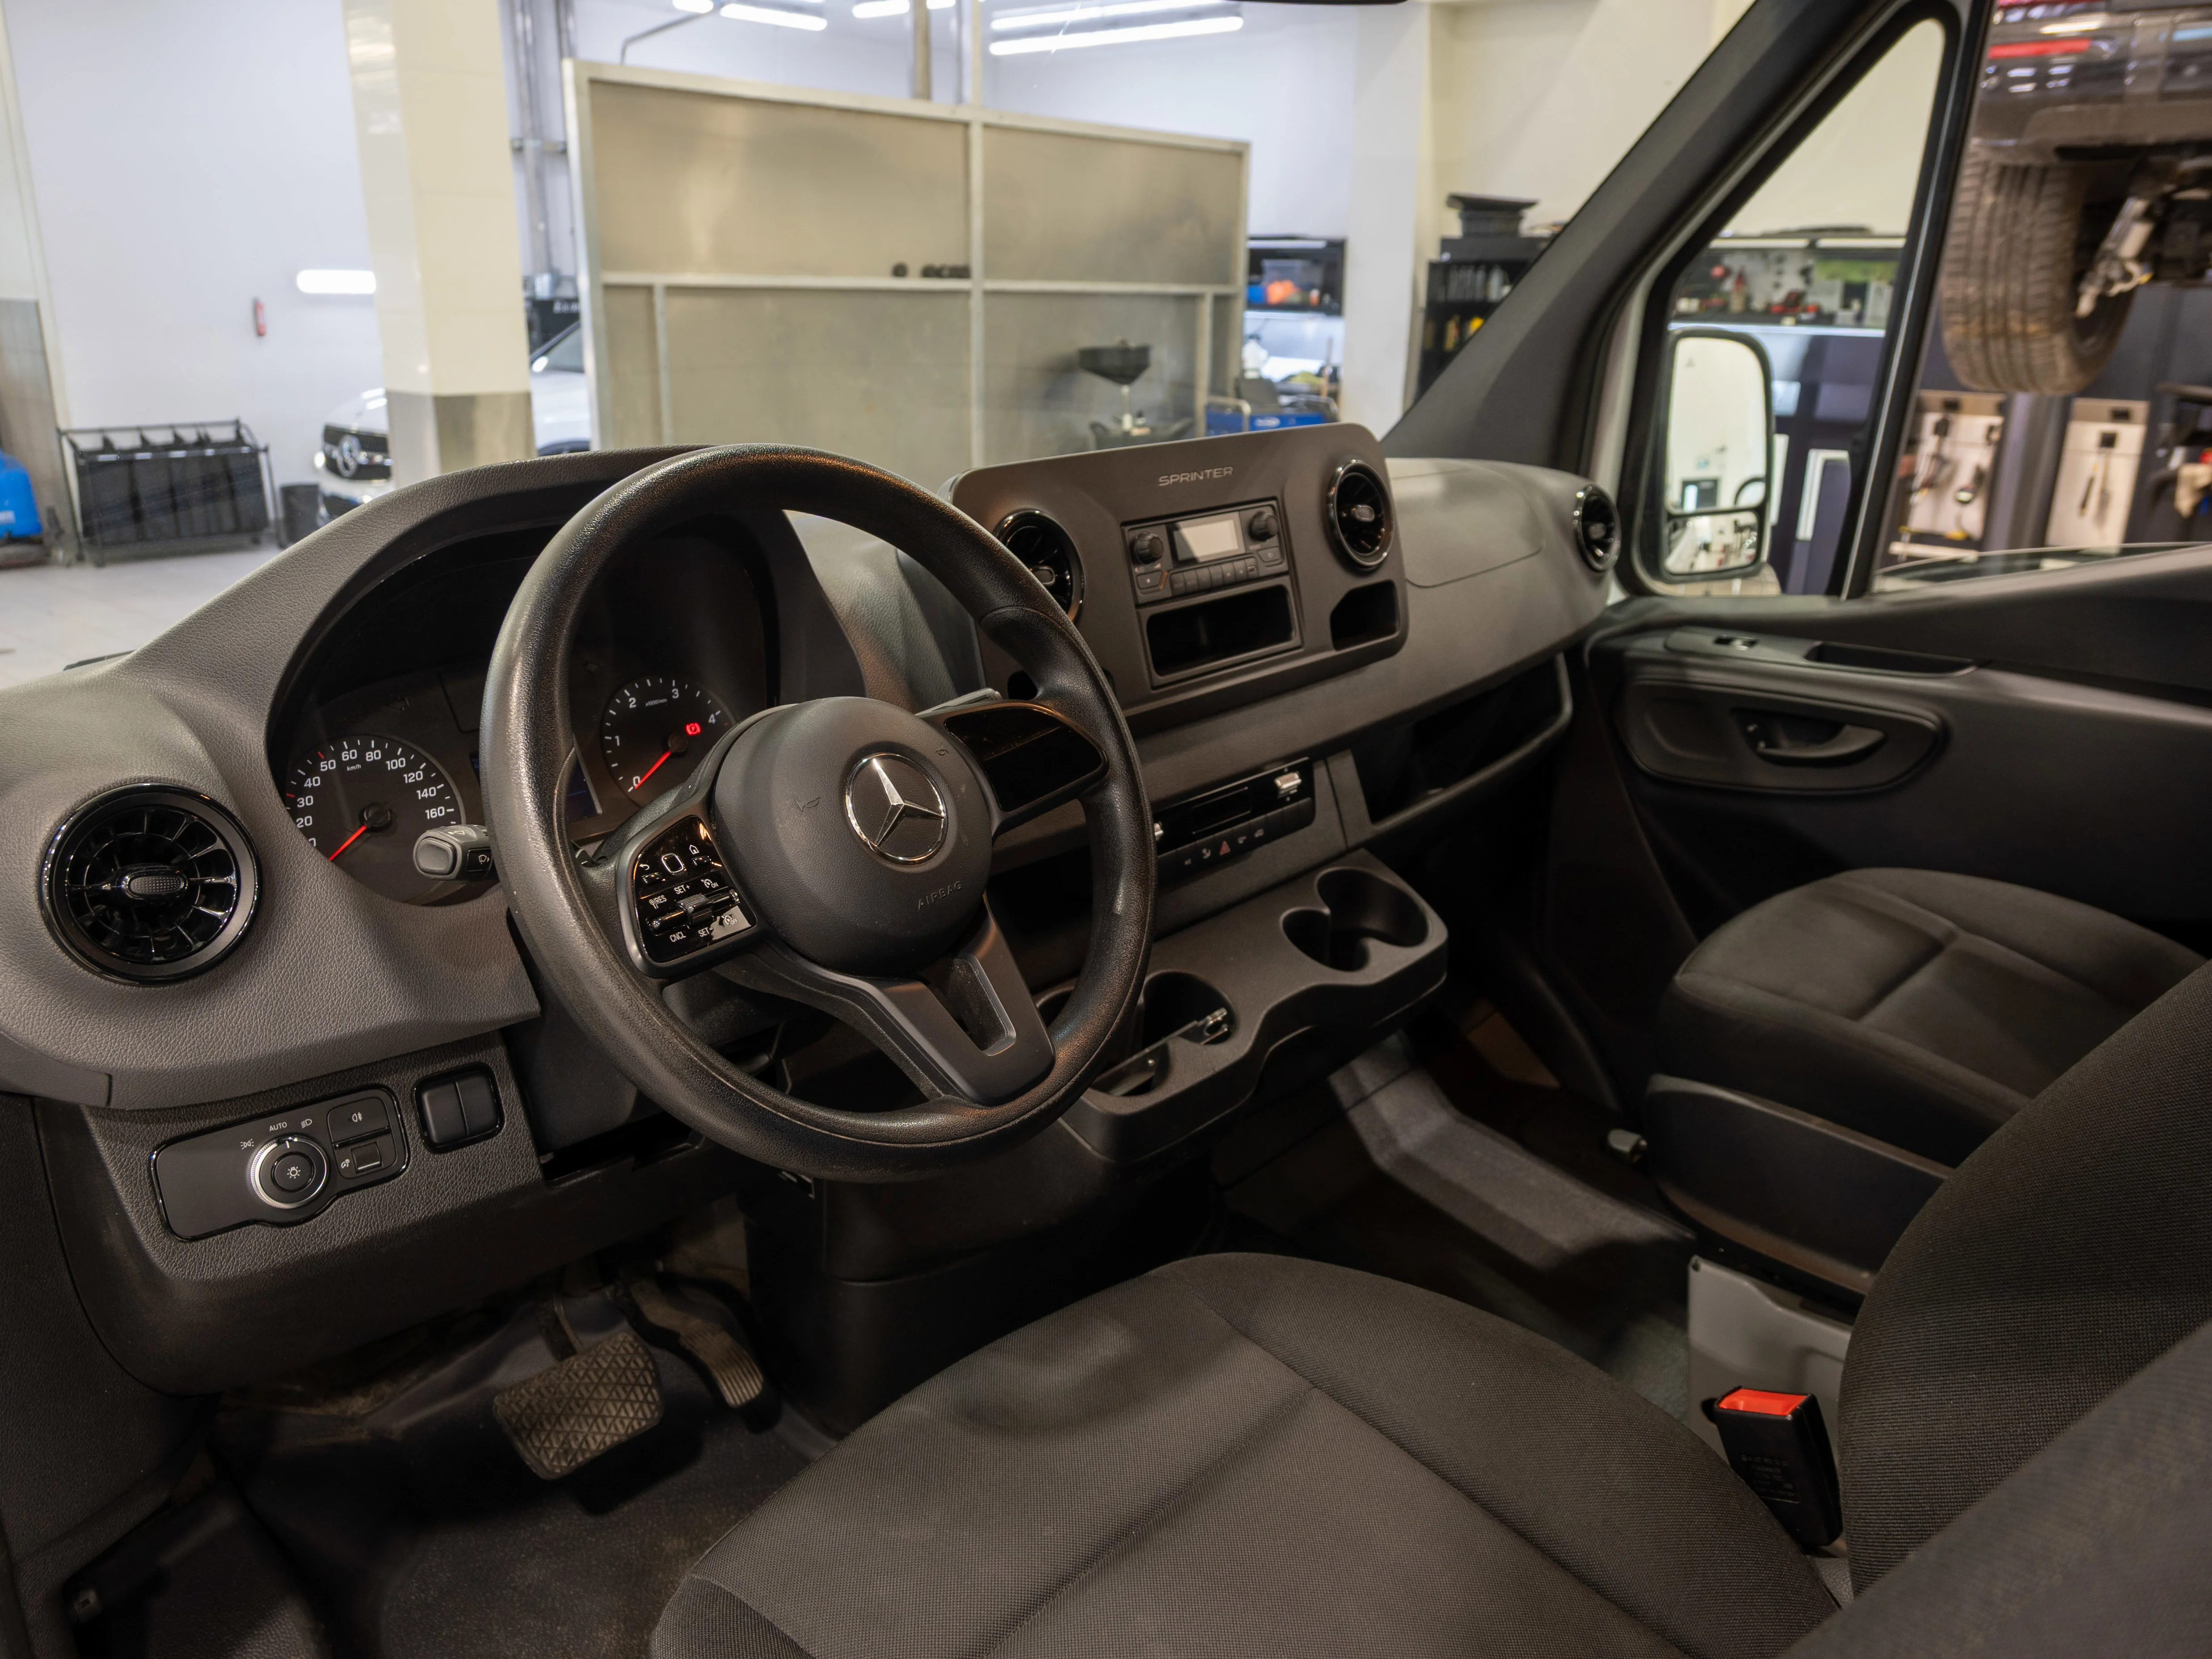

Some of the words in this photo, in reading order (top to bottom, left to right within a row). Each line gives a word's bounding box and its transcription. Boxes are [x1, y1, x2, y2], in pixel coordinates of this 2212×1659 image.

[1159, 466, 1234, 487] SPRINTER
[672, 688, 679, 699] 3
[629, 697, 636, 708] 2
[708, 714, 716, 724] 4
[615, 736, 620, 746] 1
[341, 749, 358, 761] 60
[366, 750, 382, 762] 80
[320, 759, 336, 771] 50
[386, 758, 406, 771] 100
[303, 776, 321, 788] 40
[403, 771, 423, 783] 120
[416, 787, 437, 800] 140
[297, 796, 314, 808] 30
[425, 806, 445, 819] 160
[296, 816, 313, 828] 20
[919, 881, 961, 910] AIRBAG
[670, 931, 687, 942] CNCL
[270, 1122, 287, 1132] AUTO
